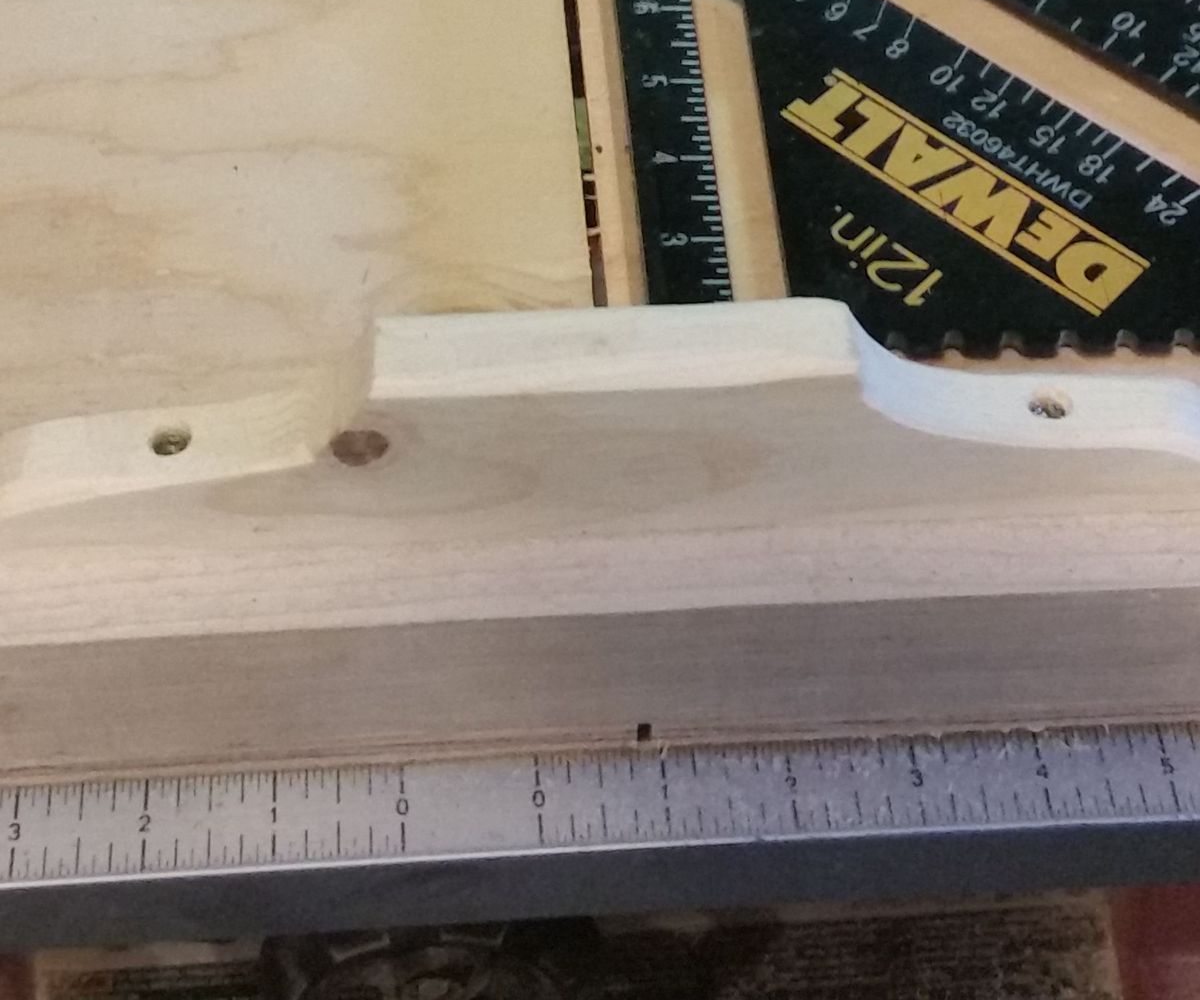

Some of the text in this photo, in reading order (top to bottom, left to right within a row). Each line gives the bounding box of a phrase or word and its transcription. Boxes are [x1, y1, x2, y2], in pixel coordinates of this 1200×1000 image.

[1111, 11, 1147, 38] 10
[642, 73, 668, 89] 5
[824, 2, 849, 21] 6
[852, 23, 880, 41] 7
[885, 38, 910, 60] 8
[929, 65, 966, 93] 10
[970, 89, 1008, 119] 12
[1028, 125, 1066, 154] 15
[1078, 154, 1115, 184] 18
[1143, 193, 1189, 226] 24
[783, 72, 1147, 313] DEWALT
[942, 110, 1094, 211] DWHT46032
[660, 232, 689, 247] 3
[830, 204, 944, 307] 12in.
[8, 822, 21, 841] 3
[139, 814, 152, 833] 2
[269, 806, 278, 824] 1
[396, 798, 409, 816] 0
[532, 789, 546, 807] 0
[910, 768, 924, 787] 3
[1035, 763, 1049, 779] 4
[1160, 756, 1175, 775] 5
